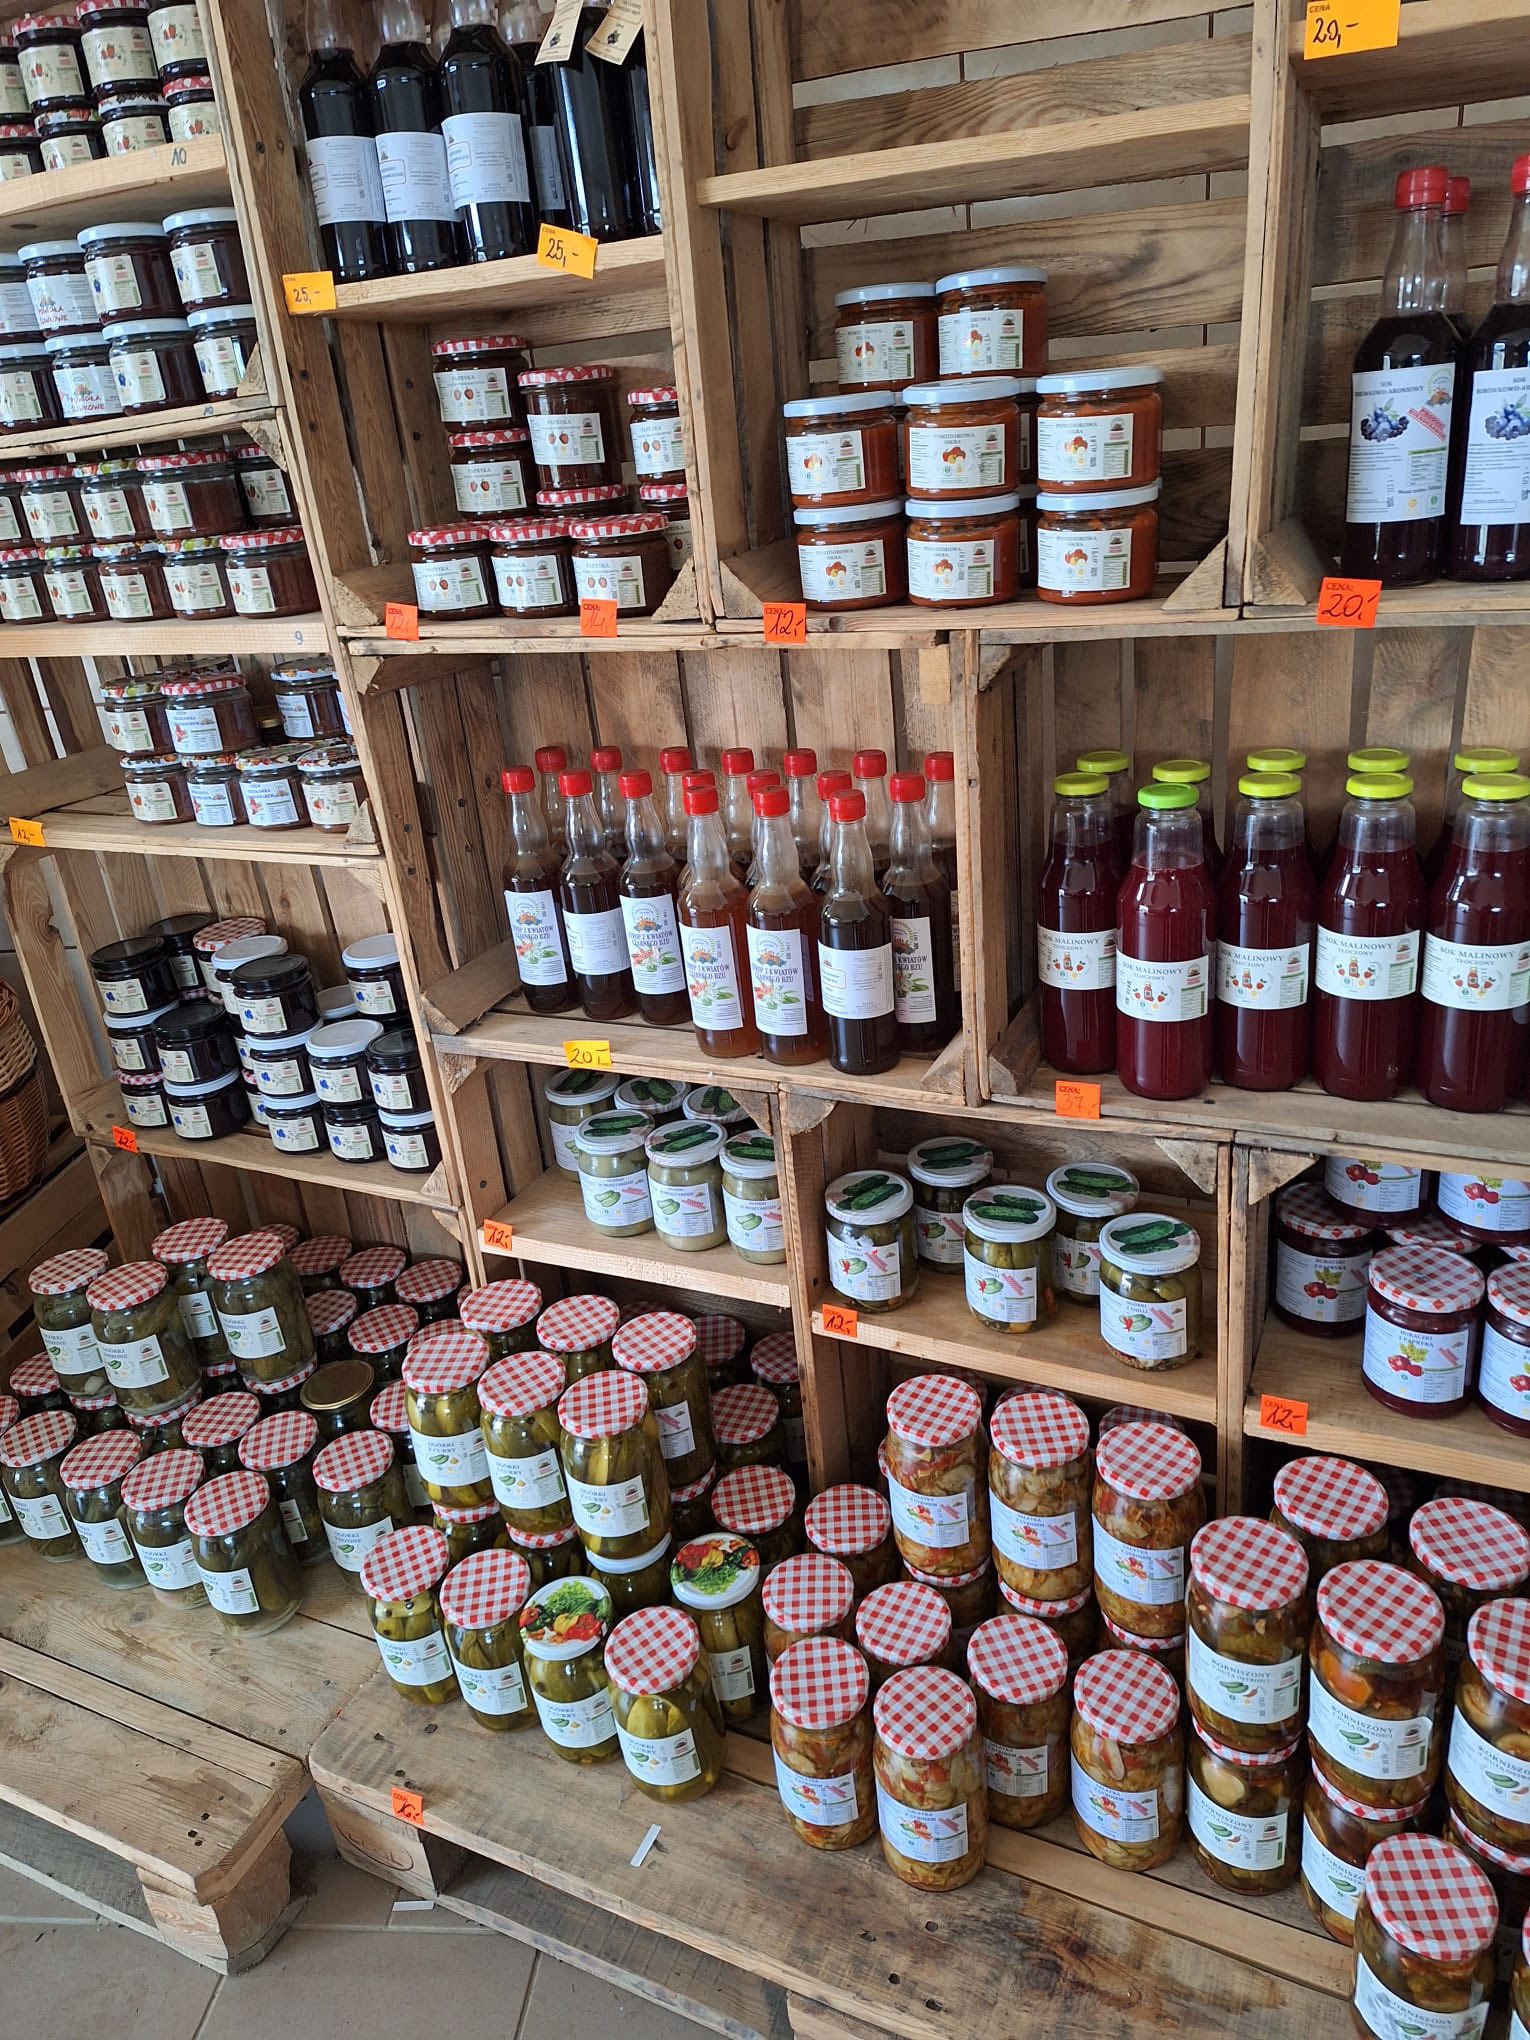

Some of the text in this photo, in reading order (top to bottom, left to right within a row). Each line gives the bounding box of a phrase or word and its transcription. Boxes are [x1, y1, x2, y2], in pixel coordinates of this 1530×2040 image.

[1308, 4, 1331, 14] CENA
[171, 147, 187, 166] 10
[545, 237, 579, 268] 25,-
[292, 286, 321, 305] 25,-
[1321, 593, 1379, 621] 20,-
[768, 610, 804, 637] 12,-
[294, 630, 304, 646] 9
[527, 925, 554, 934] KWIATÓW
[540, 932, 551, 940] BZU
[647, 930, 673, 940] KWIATÓW
[659, 938, 670, 947] BZU
[1053, 936, 1100, 945] MALINOWY
[1340, 940, 1393, 950] MALINOWY
[1233, 952, 1284, 962] MALINOWY
[1459, 950, 1515, 960] MALINOWY
[701, 963, 730, 972] KWIATÓW
[769, 966, 800, 975] KWIATÓW
[910, 963, 923, 971] BZU
[1135, 966, 1184, 975] MALINOWY
[713, 971, 727, 980] BZU
[781, 974, 794, 983] BZU
[487, 1229, 510, 1249] 12,-
[825, 1315, 854, 1335] 12,-
[1266, 1405, 1305, 1432] 12,-
[1211, 1659, 1271, 1680] KORNISZONY
[1332, 1705, 1393, 1734] KORNISZONY
[1201, 1799, 1254, 1830] KORNISZONY
